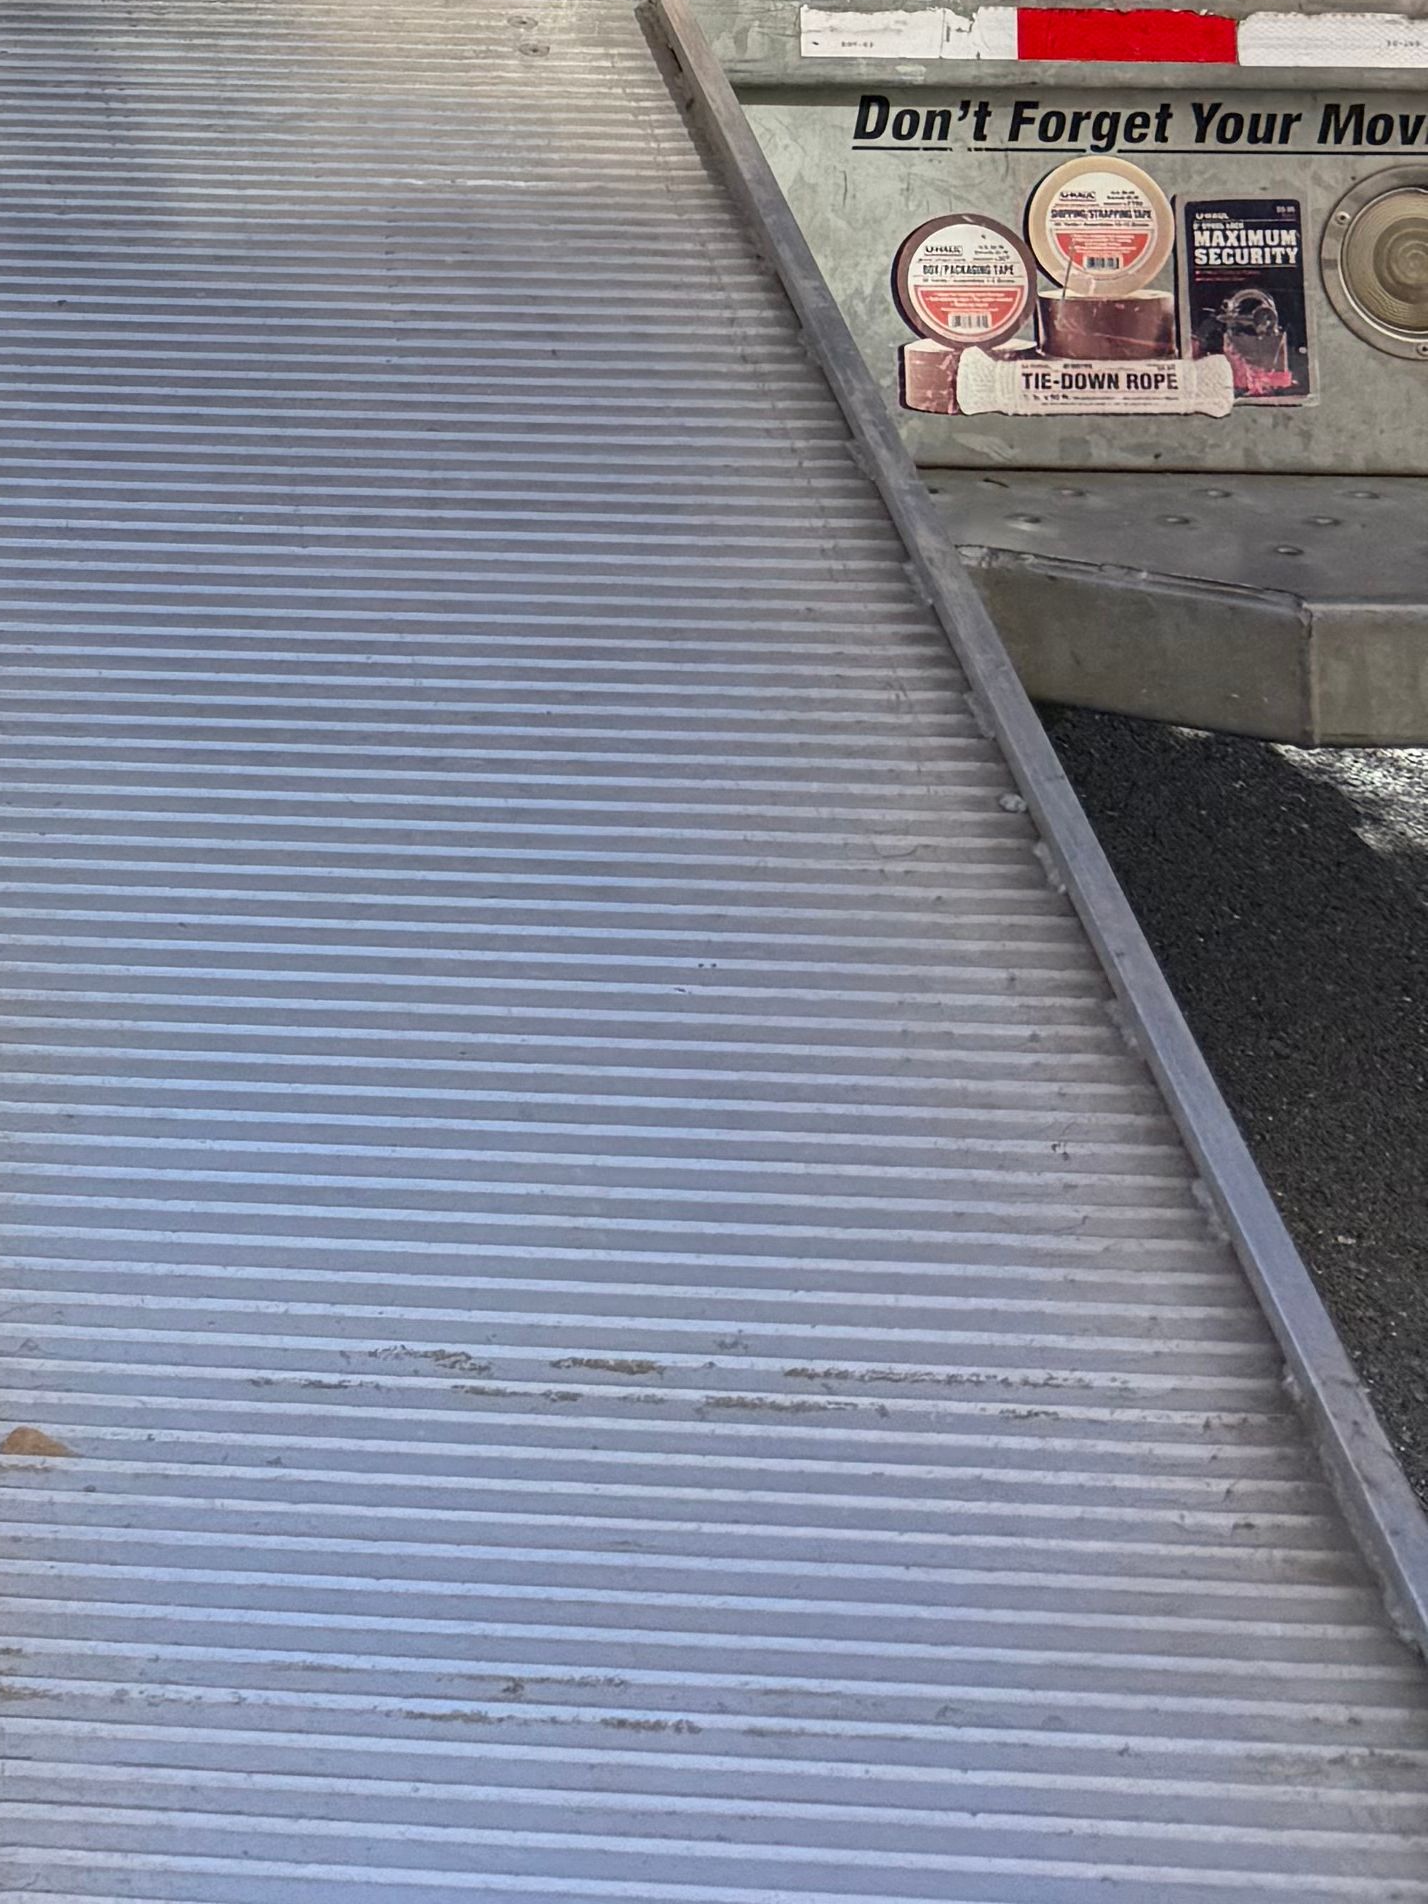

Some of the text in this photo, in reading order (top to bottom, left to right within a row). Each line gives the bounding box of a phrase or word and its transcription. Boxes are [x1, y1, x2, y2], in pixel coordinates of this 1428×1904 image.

[852, 94, 1428, 154] Don't Forget Your Mov
[1194, 229, 1297, 247] MAXIMUM
[1194, 247, 1298, 265] SECURITY
[994, 264, 1015, 276] TAPE
[1021, 372, 1179, 390] TIE-DOWN ROPE
